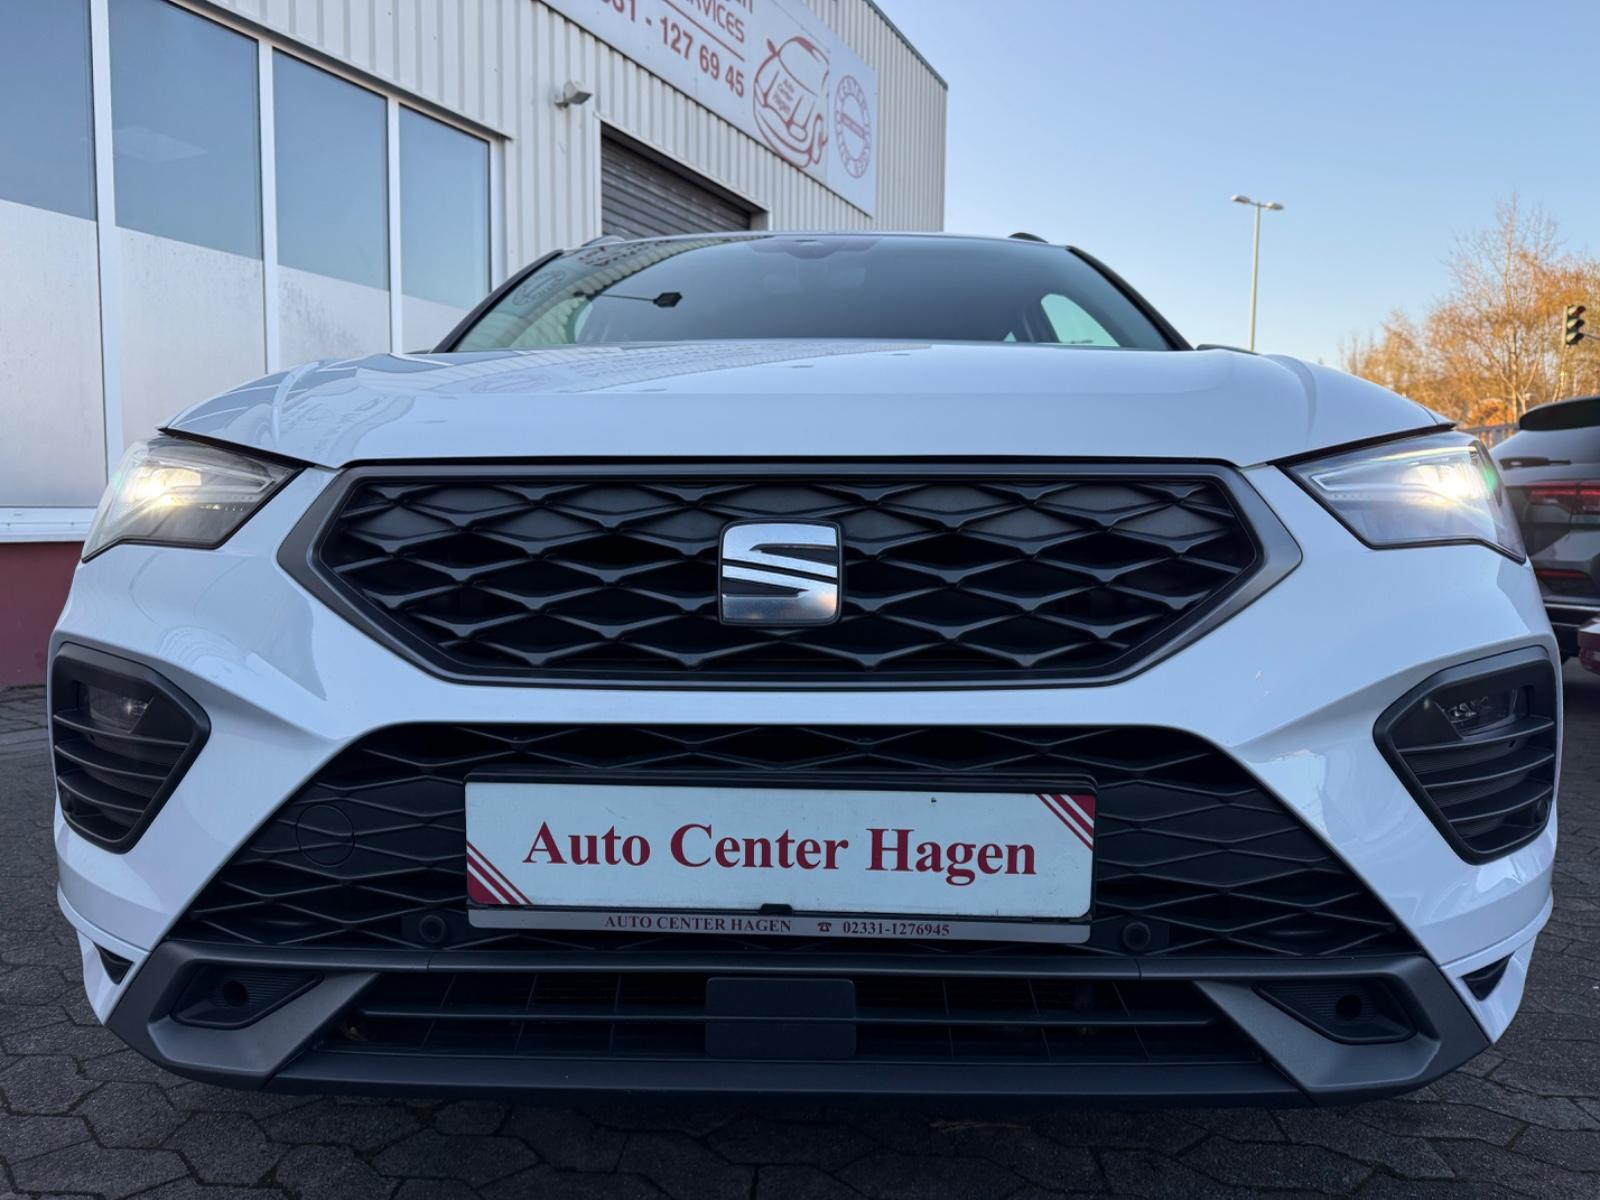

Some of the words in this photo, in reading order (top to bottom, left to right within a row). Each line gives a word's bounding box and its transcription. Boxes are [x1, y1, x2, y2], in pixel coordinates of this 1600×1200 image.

[660, 15, 693, 60] 127
[699, 44, 720, 81] 69
[725, 64, 745, 98] 45
[522, 821, 650, 867] Auto
[670, 823, 849, 870] Center
[865, 828, 1037, 887] Hagen
[605, 915, 652, 929] AUTO
[656, 917, 725, 931] CENTER
[731, 918, 792, 932] HAGEN
[842, 921, 951, 936] 02331-1276945
